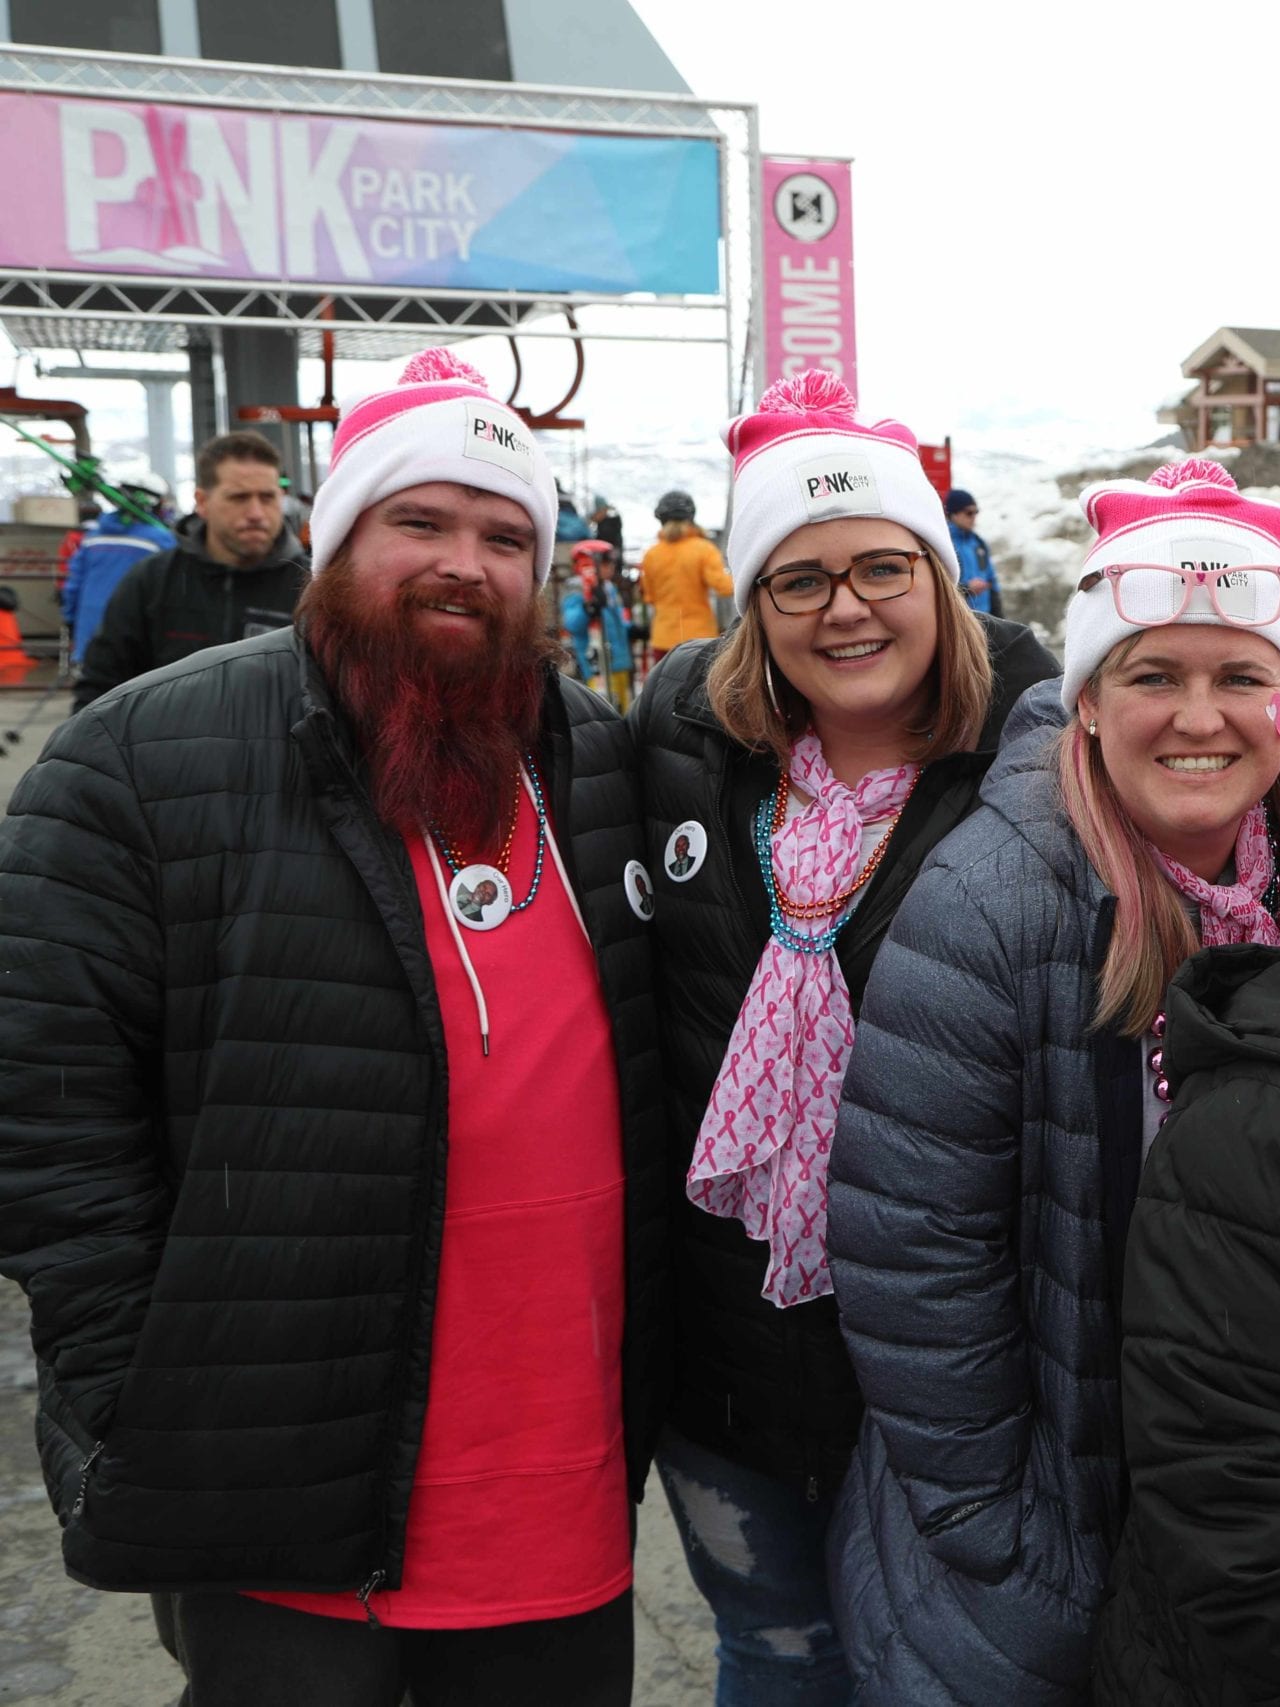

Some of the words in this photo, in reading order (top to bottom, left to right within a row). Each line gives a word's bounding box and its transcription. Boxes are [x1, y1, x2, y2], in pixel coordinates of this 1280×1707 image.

[351, 166, 477, 215] PARK
[369, 215, 479, 262] CITY
[1228, 572, 1248, 580] PARK
[1231, 578, 1249, 587] CITY
